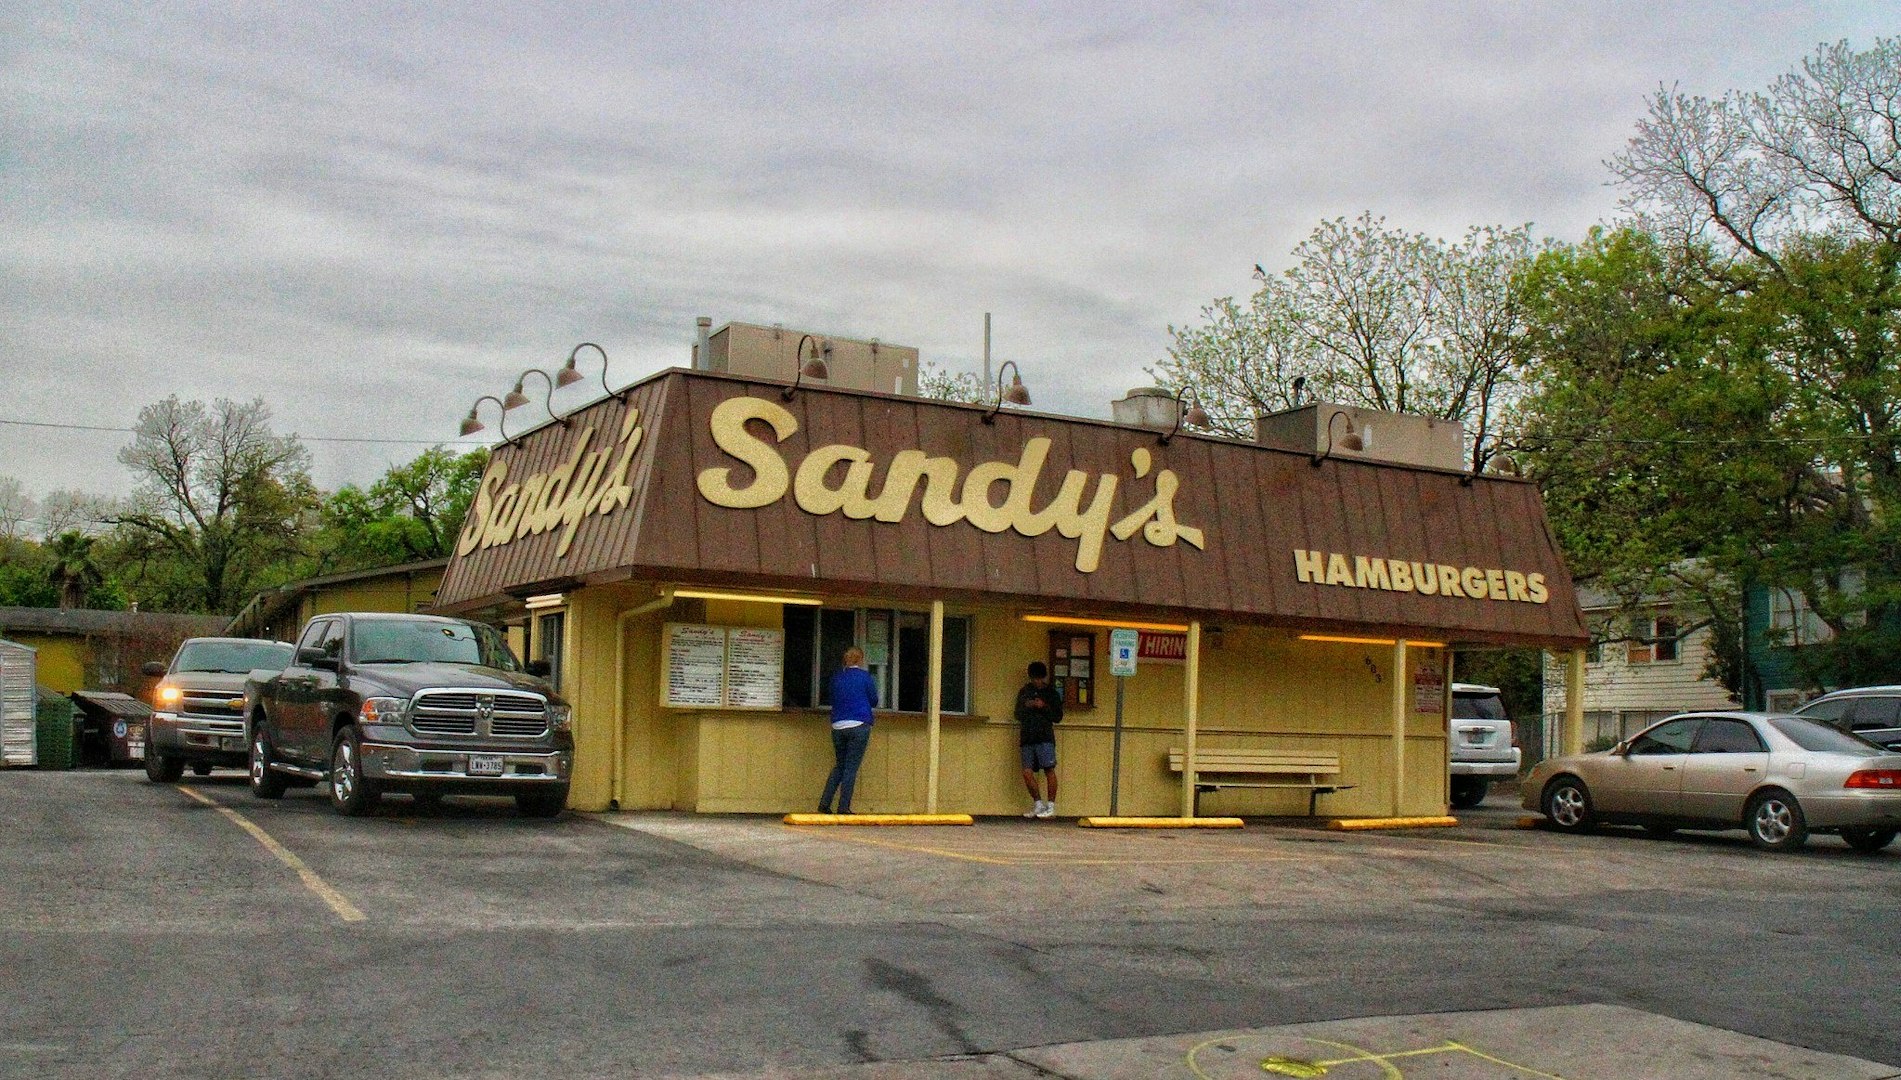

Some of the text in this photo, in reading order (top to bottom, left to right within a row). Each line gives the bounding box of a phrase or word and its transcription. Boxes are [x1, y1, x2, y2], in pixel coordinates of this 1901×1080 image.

[458, 408, 643, 557] Sandy's
[697, 396, 1204, 573] Sandy's
[1294, 549, 1549, 604] HAMBURGERS
